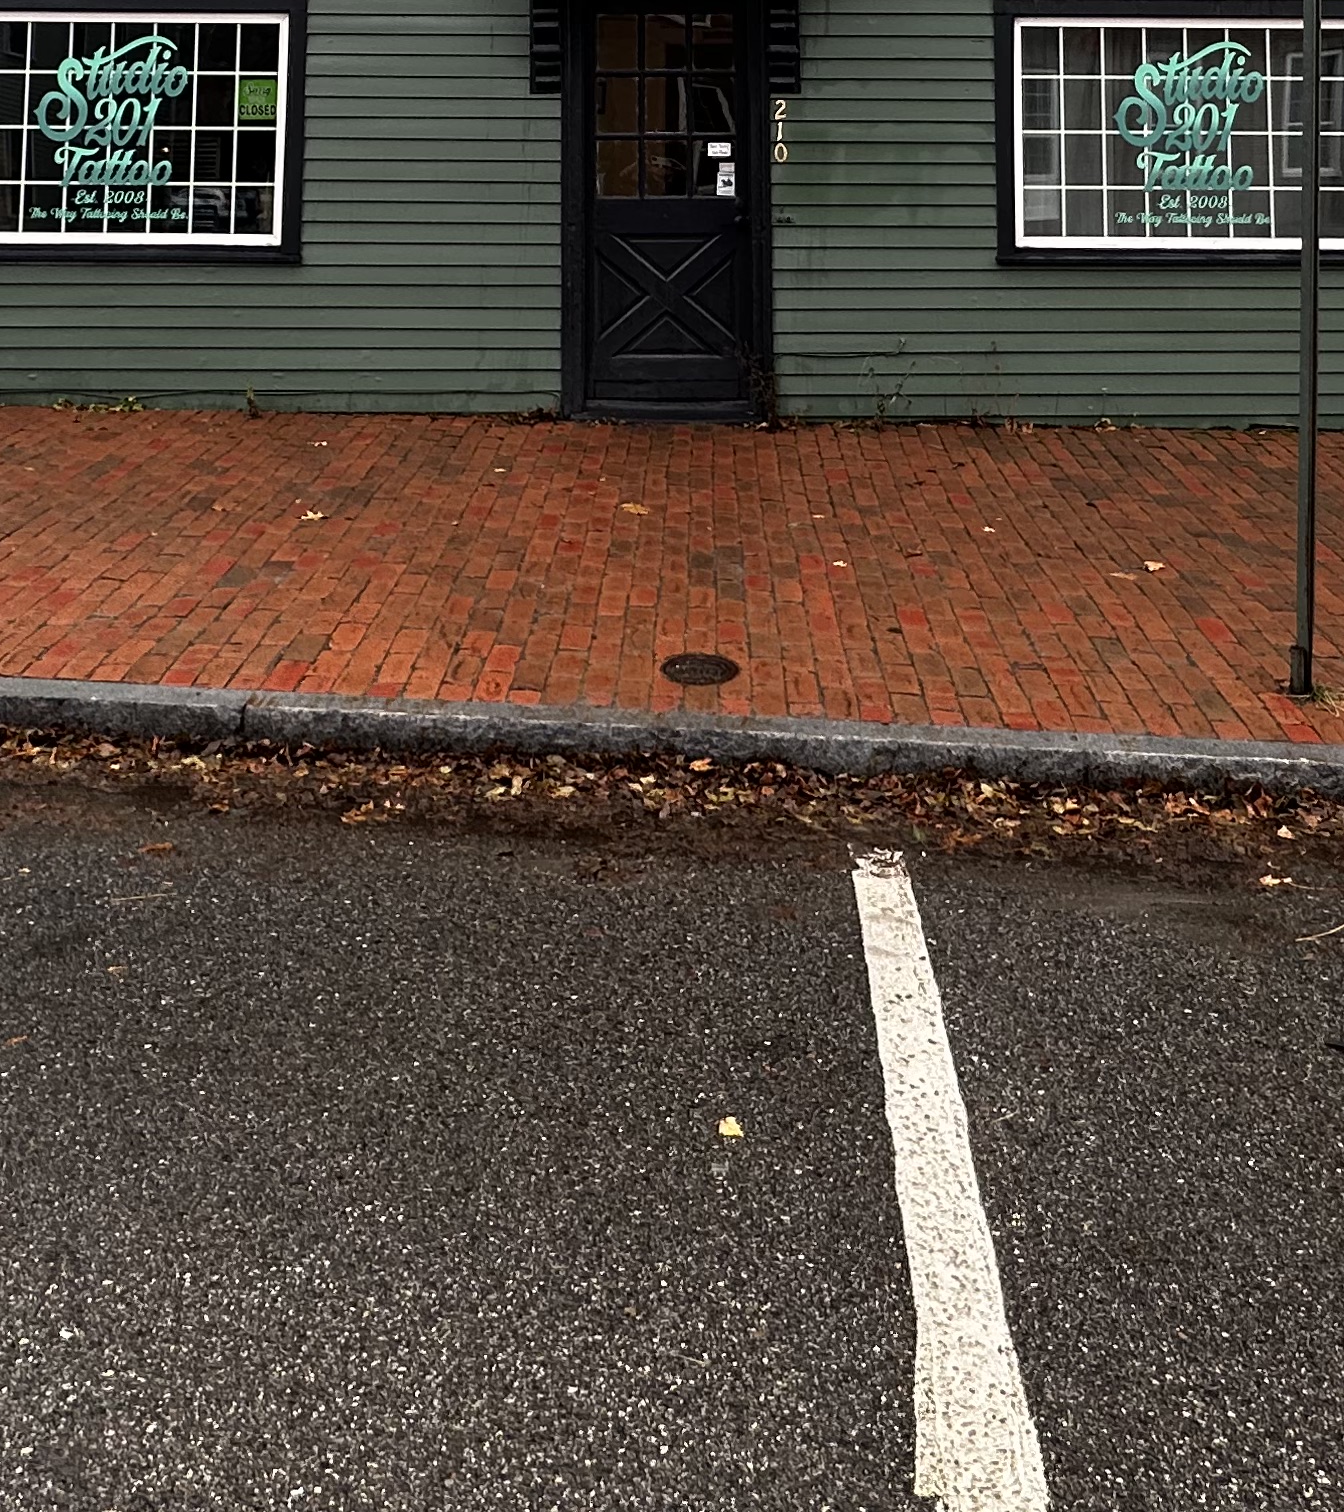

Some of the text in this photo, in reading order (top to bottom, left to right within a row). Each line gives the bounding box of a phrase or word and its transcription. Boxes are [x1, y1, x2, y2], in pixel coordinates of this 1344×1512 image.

[33, 35, 188, 142] Studio
[1113, 41, 1264, 146] Studio
[84, 97, 163, 146] 201
[239, 104, 276, 116] CLOSED
[1165, 103, 1239, 151] 201
[774, 99, 788, 163] 210
[54, 146, 173, 187] Tattoo
[1136, 151, 1254, 192] Tattoo
[29, 206, 47, 219] The
[50, 207, 76, 222] Way
[131, 207, 168, 220] Should
[1115, 211, 1133, 224] The
[1136, 212, 1162, 228] Way
[1190, 195, 1228, 209] 2008
